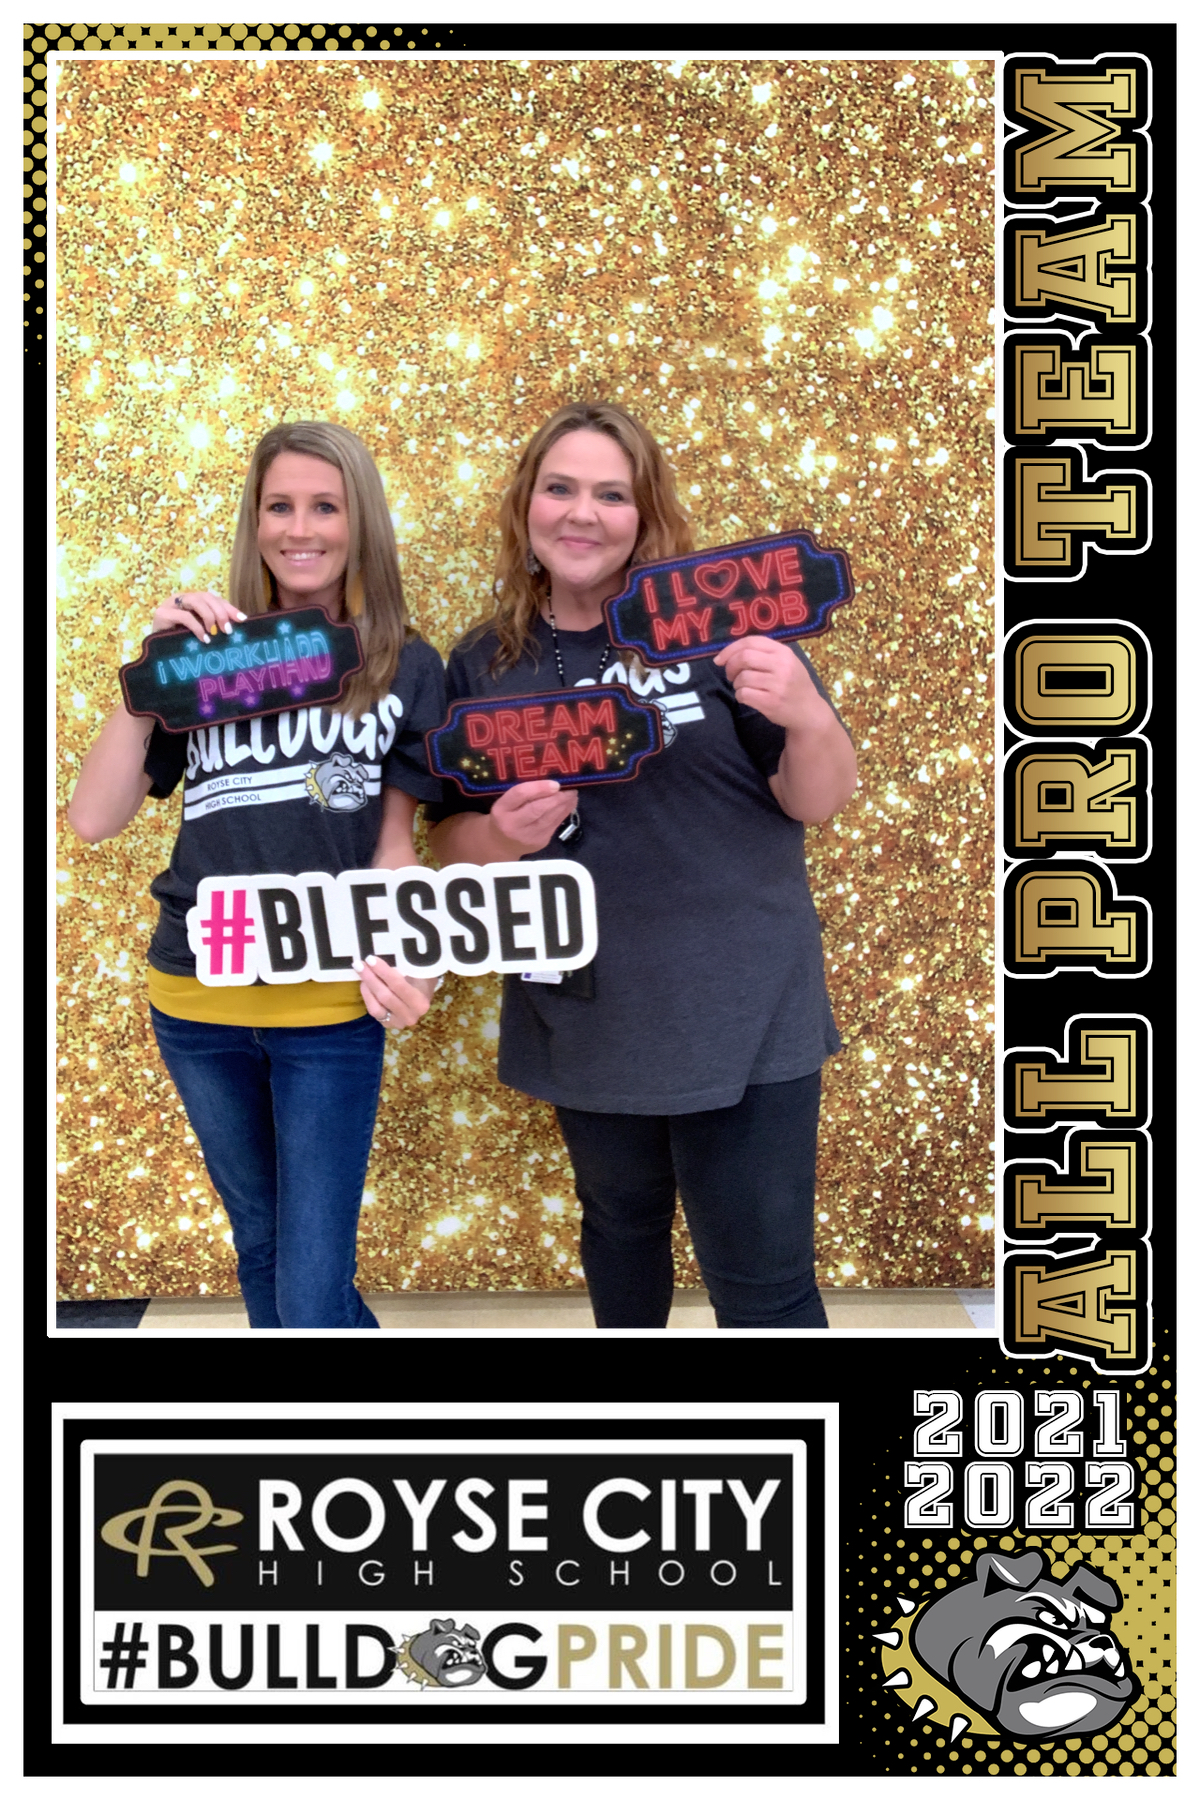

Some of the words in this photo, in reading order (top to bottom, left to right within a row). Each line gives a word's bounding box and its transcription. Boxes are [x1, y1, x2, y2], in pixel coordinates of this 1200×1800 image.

[643, 577, 658, 613] I
[653, 607, 712, 652] MY
[728, 590, 808, 638] JOB
[170, 643, 264, 681] WORK
[199, 667, 266, 702] PLAY
[466, 698, 616, 749] DREAM
[486, 737, 605, 782] TEAM
[205, 800, 221, 811] HIGH
[221, 793, 262, 807] SCHOOL
[206, 779, 230, 792] ROYSE
[231, 777, 253, 786] CITY
[200, 873, 584, 975] #BLESSED
